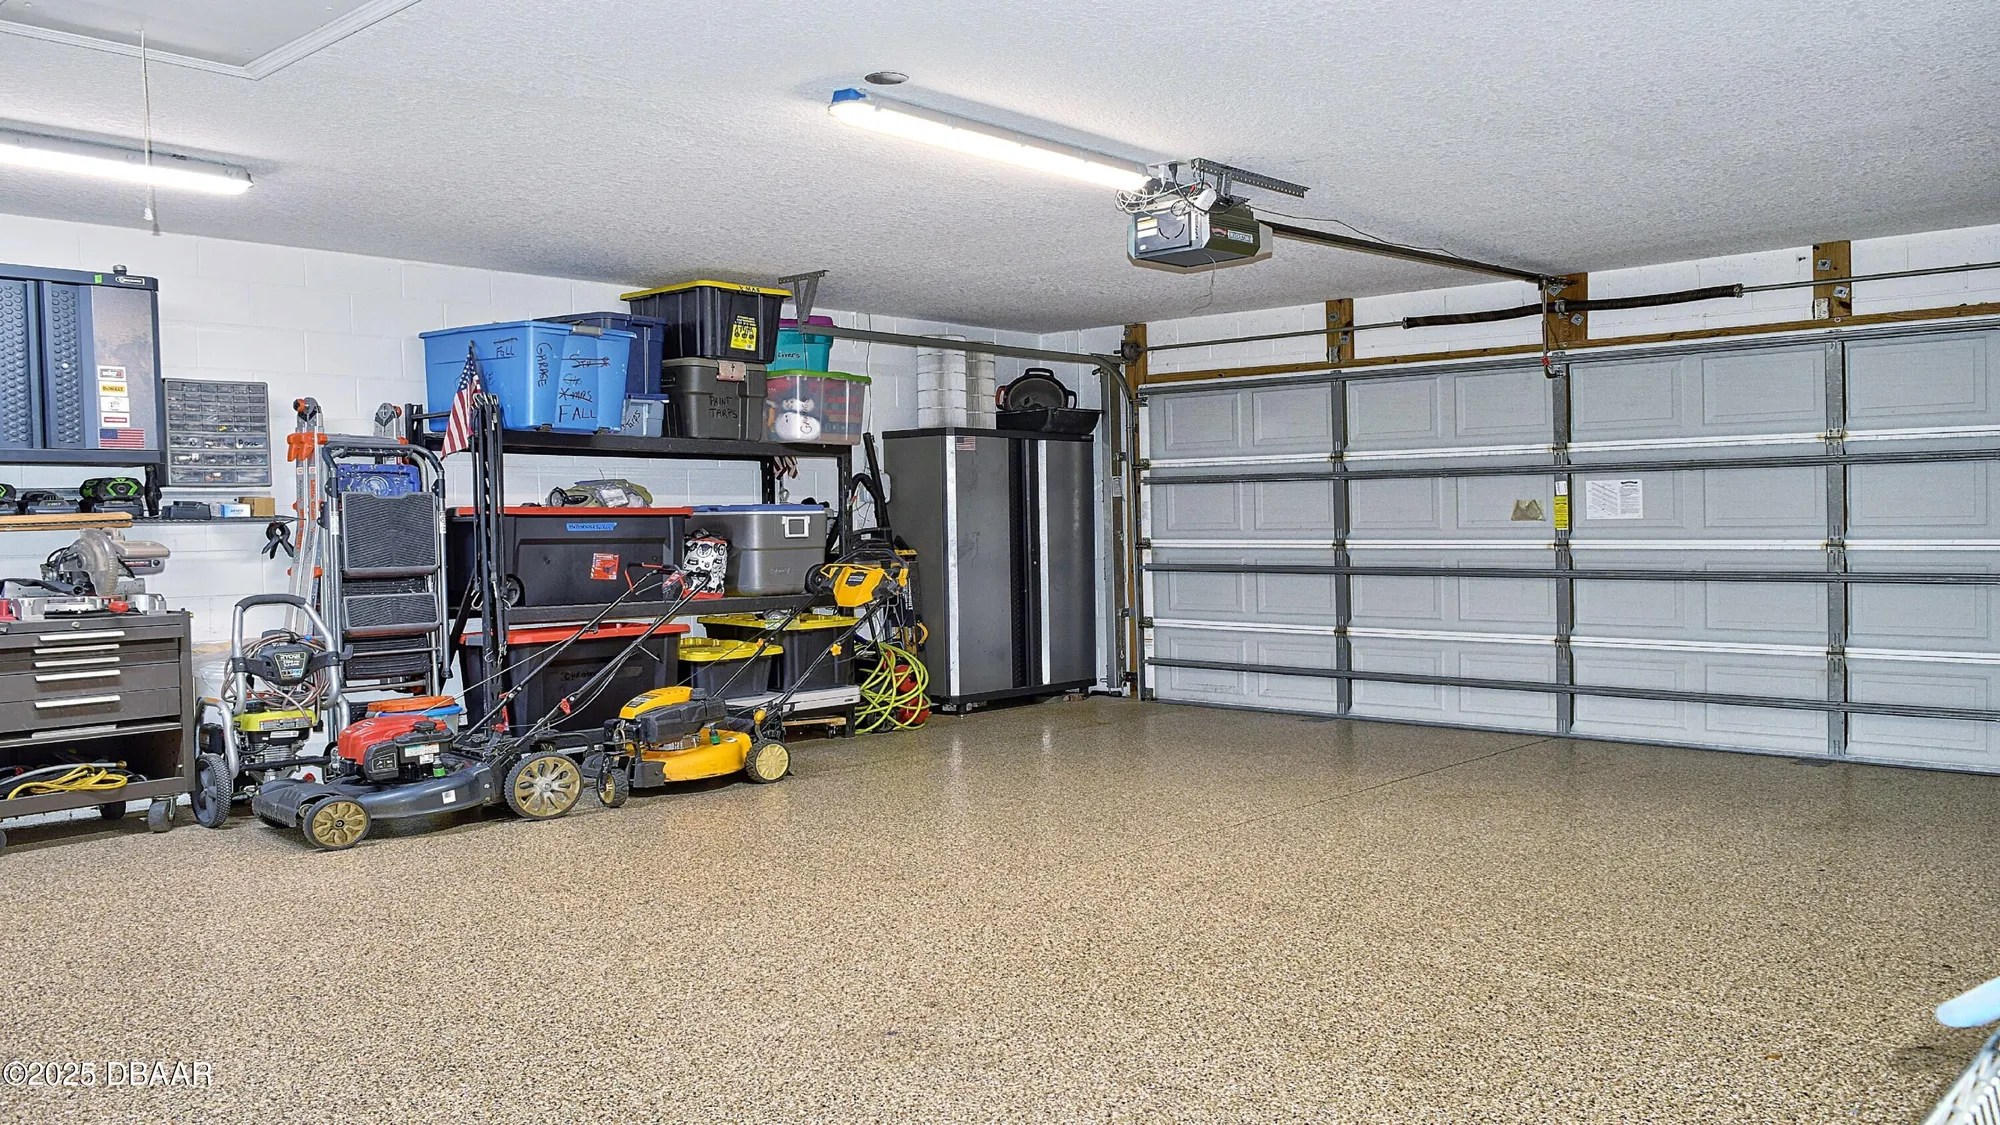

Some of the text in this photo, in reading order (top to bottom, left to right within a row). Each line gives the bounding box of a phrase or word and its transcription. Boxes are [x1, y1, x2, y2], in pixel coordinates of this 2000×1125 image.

[709, 395, 732, 407] PAINT
[558, 404, 597, 423] FALL
[709, 408, 739, 419] TARPS
